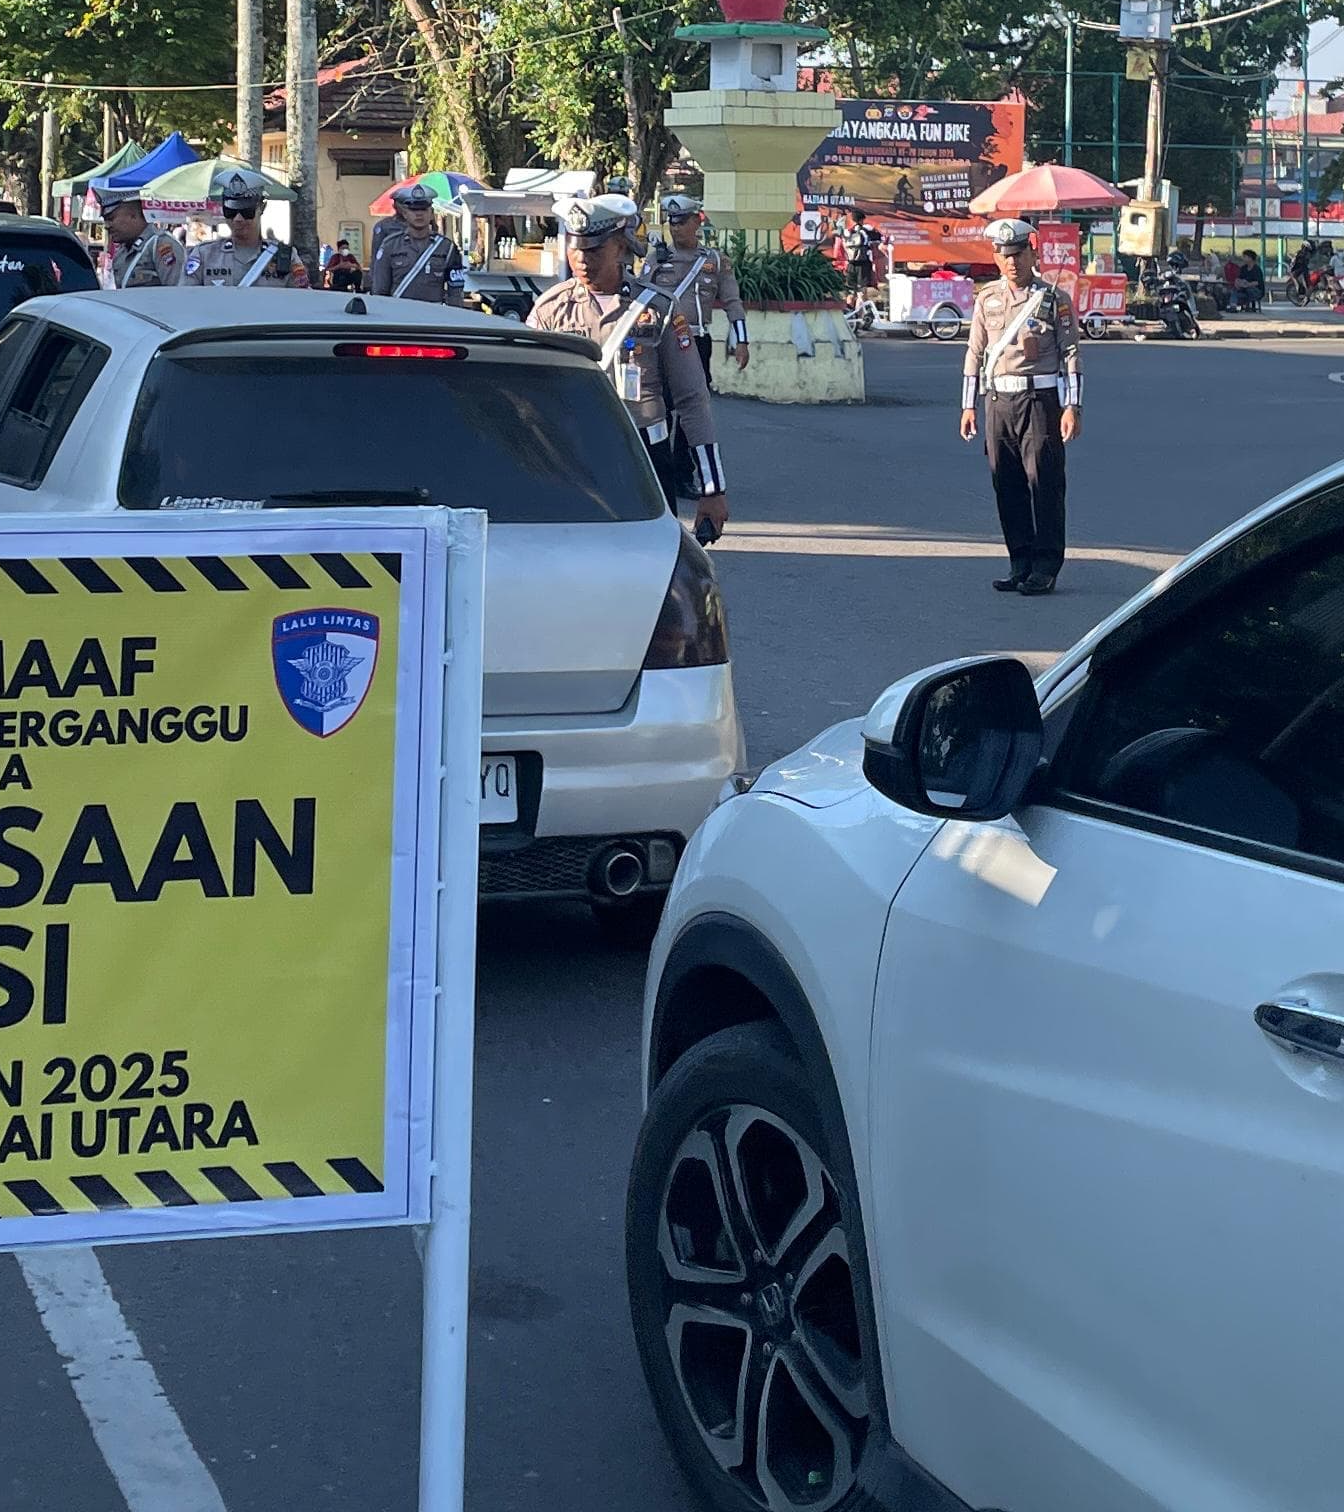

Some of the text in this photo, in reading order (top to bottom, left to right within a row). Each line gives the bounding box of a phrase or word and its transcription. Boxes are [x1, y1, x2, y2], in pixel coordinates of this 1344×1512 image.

[920, 122, 942, 142] FUN
[944, 123, 970, 143] BIKE
[282, 615, 370, 632] LALU LINTAS
[40, 1050, 190, 1106] 2025
[70, 1099, 259, 1158] UTARA
